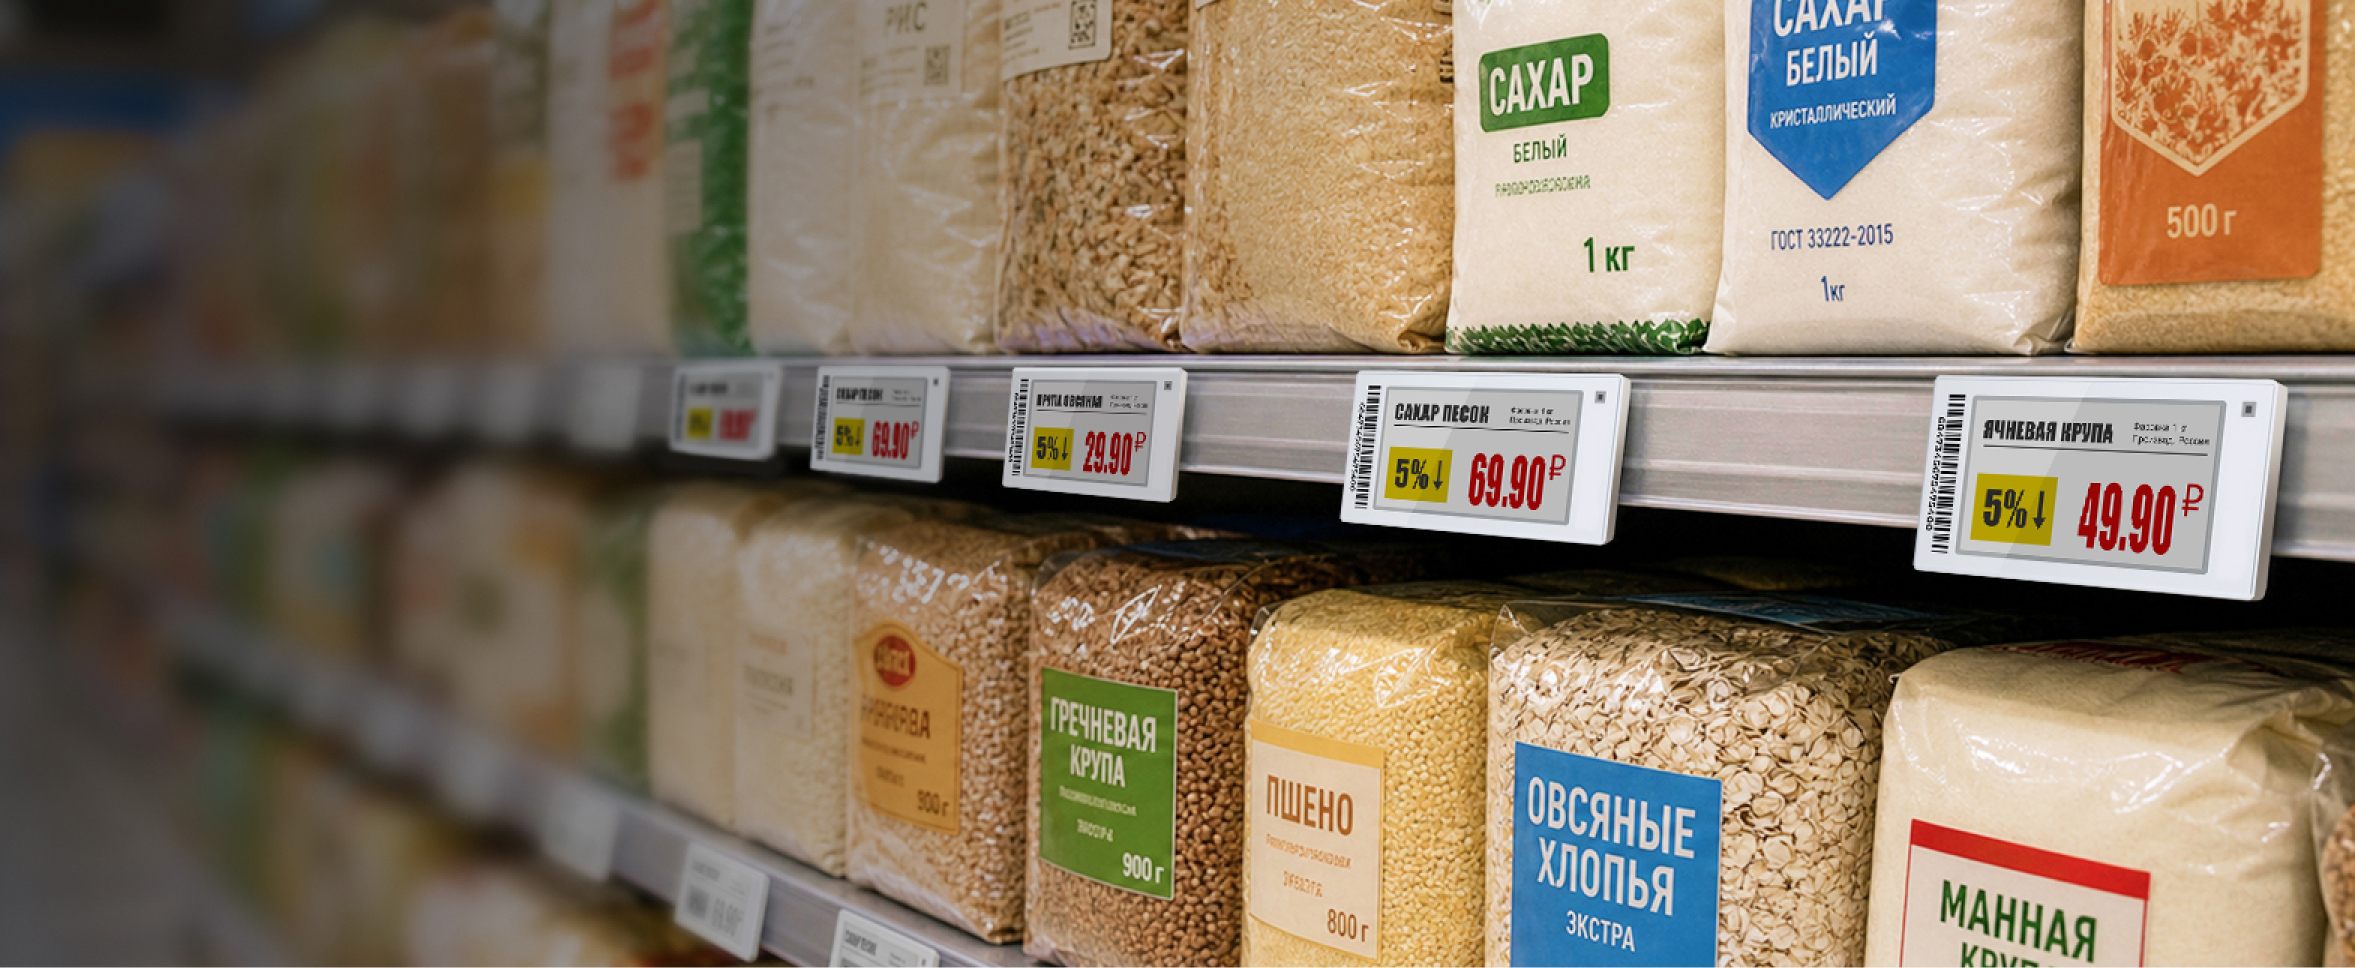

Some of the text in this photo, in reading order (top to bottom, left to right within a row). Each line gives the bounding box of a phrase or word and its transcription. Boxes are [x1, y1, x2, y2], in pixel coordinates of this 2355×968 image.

[1786, 31, 1879, 87] БЕЛЫЙ
[1489, 53, 1595, 117] САХАР
[1770, 93, 1897, 130] КРИСТАЛЛИЧЕСКИЙ
[1512, 133, 1568, 164] БЕЛЫЙ
[1771, 223, 1894, 251] ГОСТ 33222-2015
[2166, 203, 2238, 240] 500 г
[1583, 236, 1635, 273] 1 кг
[1394, 402, 1441, 423] САХАР
[1442, 403, 1490, 424] ПЕСОК
[1983, 418, 2114, 445] ЯЧНЕВАЯ КРУПА
[1036, 435, 1060, 461] 5%
[1394, 457, 1430, 491] 5%
[1983, 487, 2028, 530] 5%
[1049, 695, 1157, 754] ГРЕЧНЕВАЯ
[1070, 743, 1126, 788] КРУПА
[1266, 773, 1354, 837] ПШЕНО
[1527, 775, 1697, 860] ОВСЯНЫЕ
[1122, 851, 1165, 884] 900 г
[1537, 837, 1675, 916] ХЛОПЬЯ
[1326, 907, 1370, 943] 800 г
[1566, 910, 1636, 952] ЭКСТРА
[1940, 878, 2098, 964] МАННАЯ
